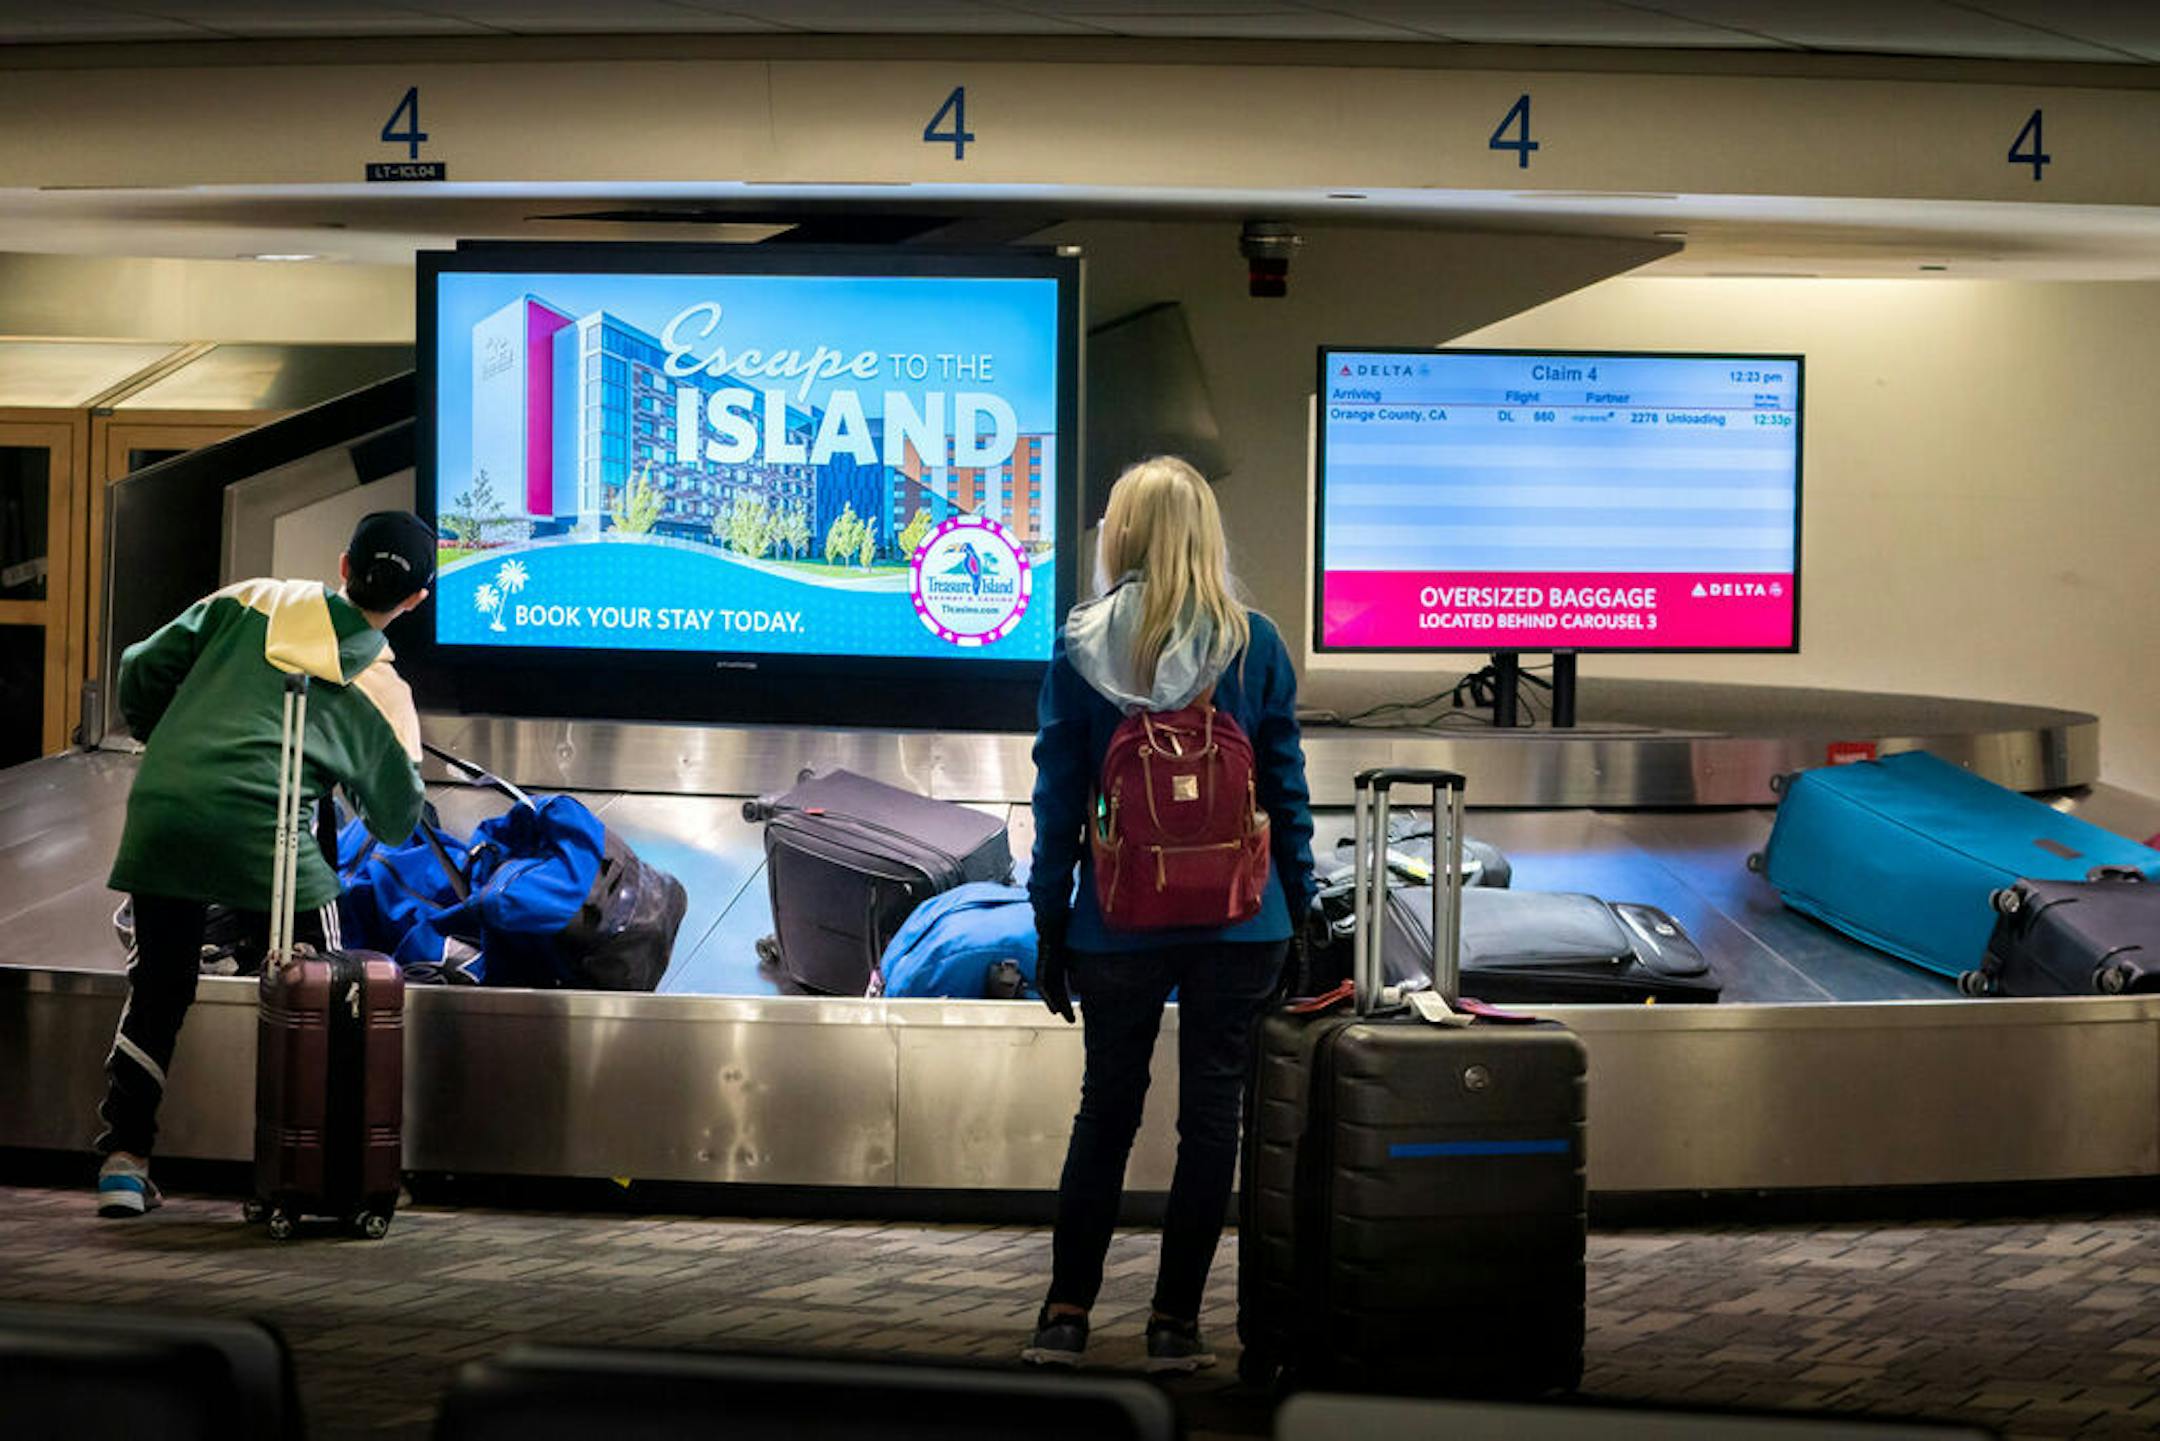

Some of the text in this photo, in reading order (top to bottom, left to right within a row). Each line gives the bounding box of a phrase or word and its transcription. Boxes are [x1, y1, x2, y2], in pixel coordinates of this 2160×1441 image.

[381, 86, 428, 160] 4
[923, 86, 975, 160] 4
[1489, 94, 1538, 169] 4
[2007, 109, 2050, 181] 4
[659, 301, 993, 402] Escape TO THE
[1357, 365, 1413, 377] DELTA
[1532, 365, 1598, 382] Claim 4
[1730, 371, 1783, 385] 12:23 pm
[1332, 388, 1382, 403] Arriving
[1505, 390, 1541, 405] Flight
[1585, 392, 1631, 404] Partner
[1330, 408, 1448, 422] Orange County, CA
[1498, 411, 1514, 422] DL
[1665, 413, 1727, 427] Unloading
[1753, 414, 1793, 427] 12:33p
[676, 387, 1018, 468] ISLAND
[927, 576, 1014, 594] Treasure Island
[1709, 583, 1767, 597] DELTA
[1420, 586, 1658, 609] OVERSIZED BAGGAGE
[515, 604, 806, 634] BOOK YOUR STAY TODAY.
[1419, 613, 1658, 630] LOCATED BEHIND CAROUSEL 3
